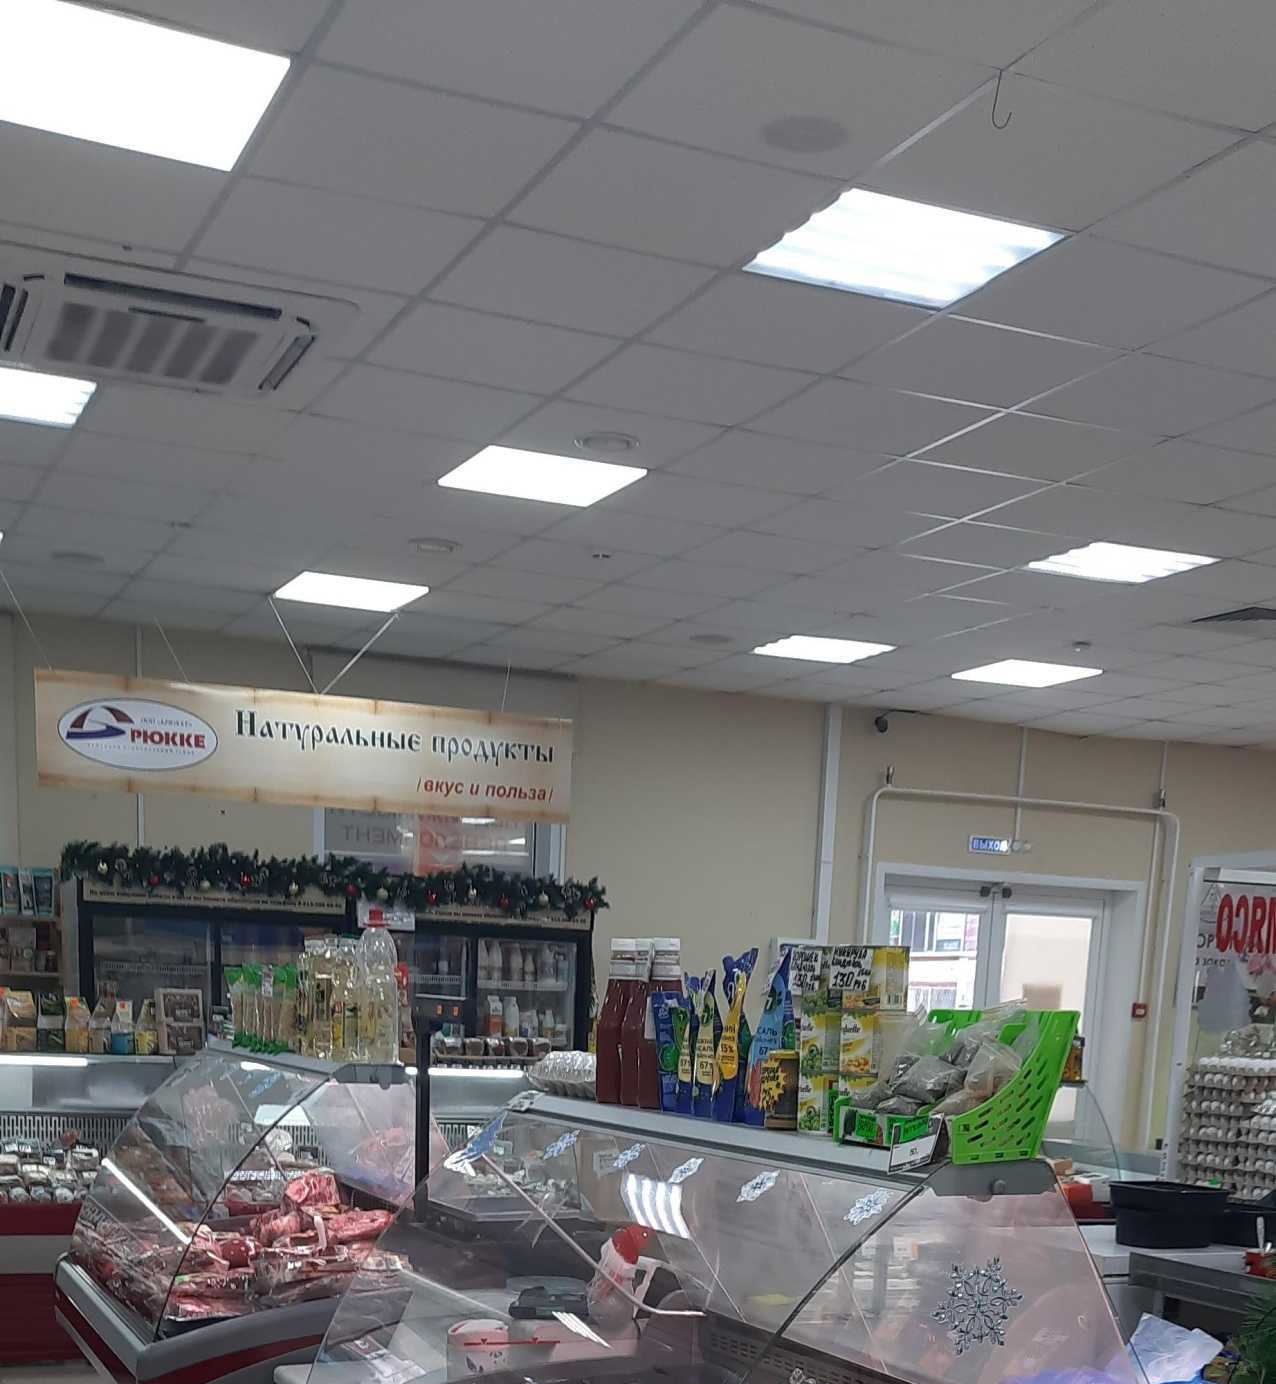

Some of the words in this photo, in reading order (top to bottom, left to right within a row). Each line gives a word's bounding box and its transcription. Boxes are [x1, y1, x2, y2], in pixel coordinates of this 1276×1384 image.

[235, 708, 422, 751] Натуральные
[432, 735, 554, 766] продукты
[469, 783, 480, 796] и
[832, 971, 855, 988] 130
